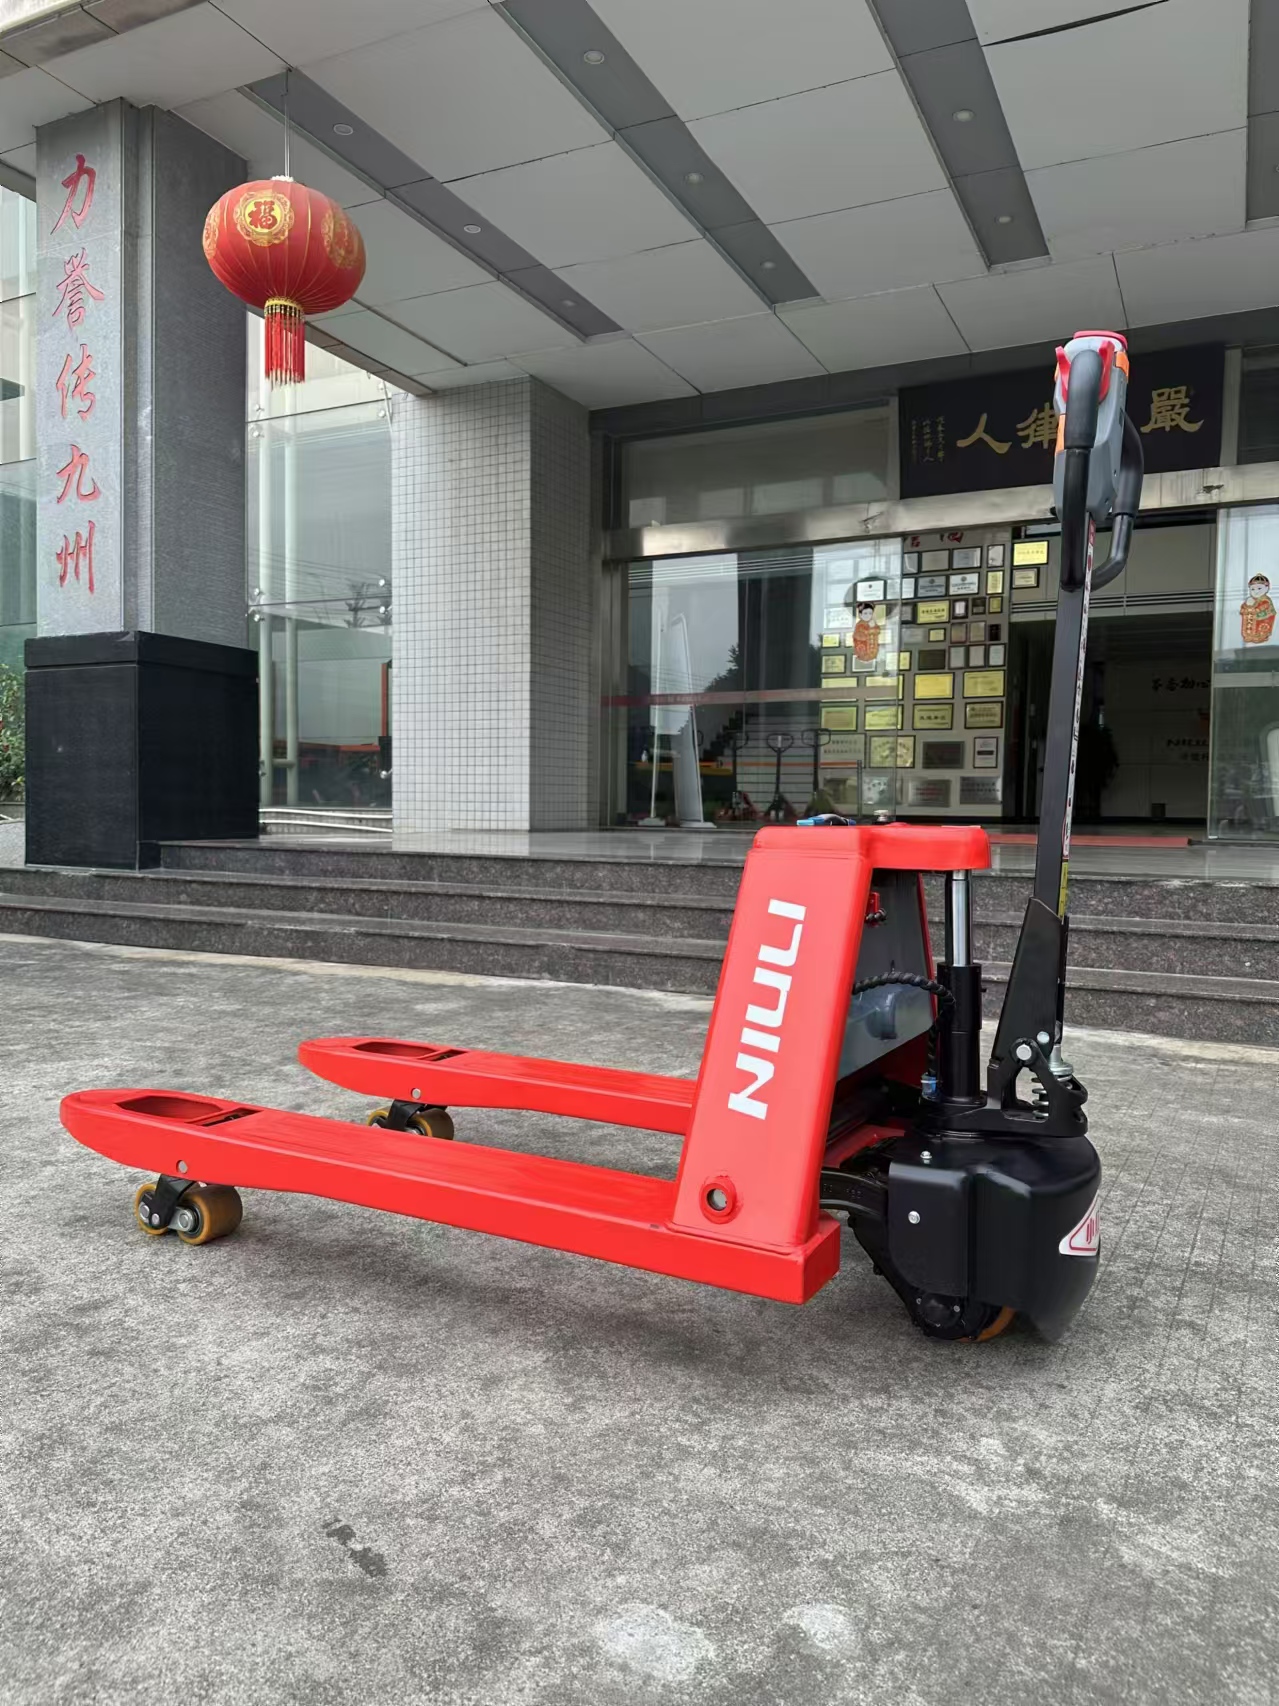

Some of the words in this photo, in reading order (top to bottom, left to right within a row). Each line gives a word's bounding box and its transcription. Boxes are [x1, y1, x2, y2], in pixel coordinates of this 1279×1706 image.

[247, 199, 278, 230] 福
[50, 153, 105, 596] 力誉传九州
[727, 898, 807, 1120] NIULI
